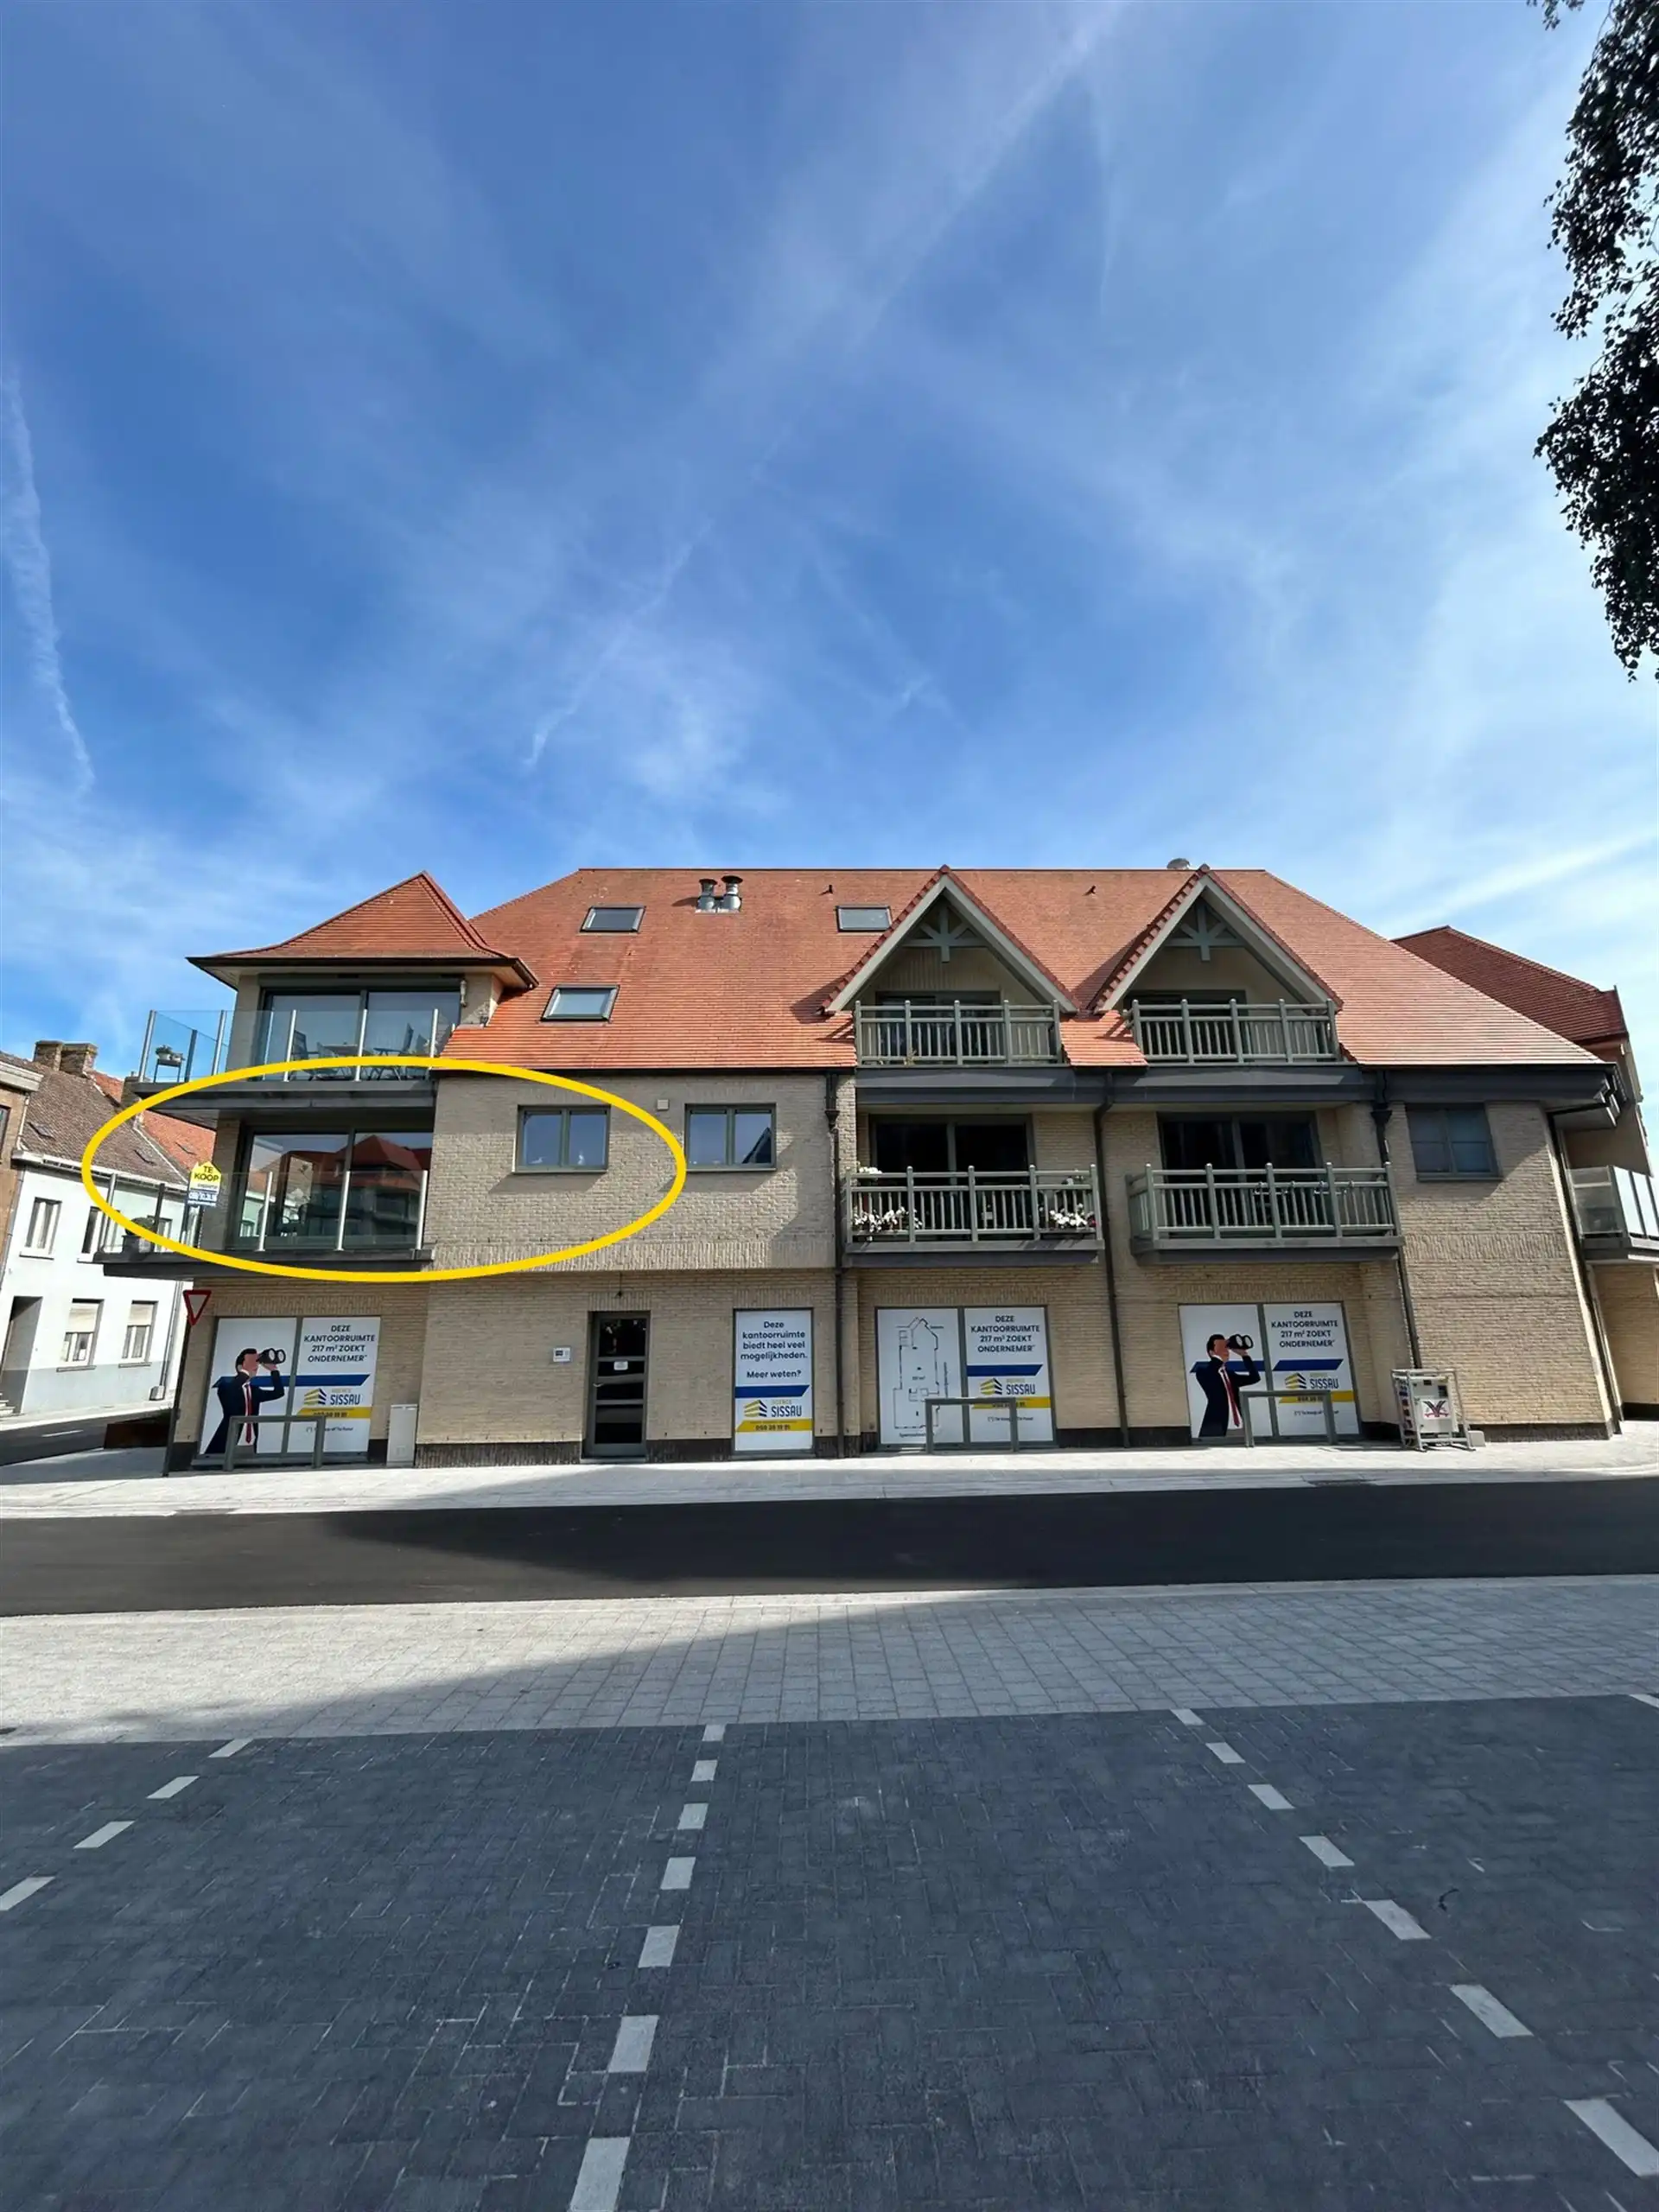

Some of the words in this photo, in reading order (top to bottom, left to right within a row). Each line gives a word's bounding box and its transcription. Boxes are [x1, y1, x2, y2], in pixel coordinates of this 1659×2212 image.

[194, 1173, 219, 1181] KOOP
[741, 1351, 808, 1362] mogelijkheden.
[770, 1370, 802, 1378] weten?
[1006, 1383, 1035, 1395] SISSAU
[1309, 1378, 1338, 1389] SISSAU
[330, 1394, 360, 1405] SISSAU
[771, 1405, 802, 1417] SISSAU
